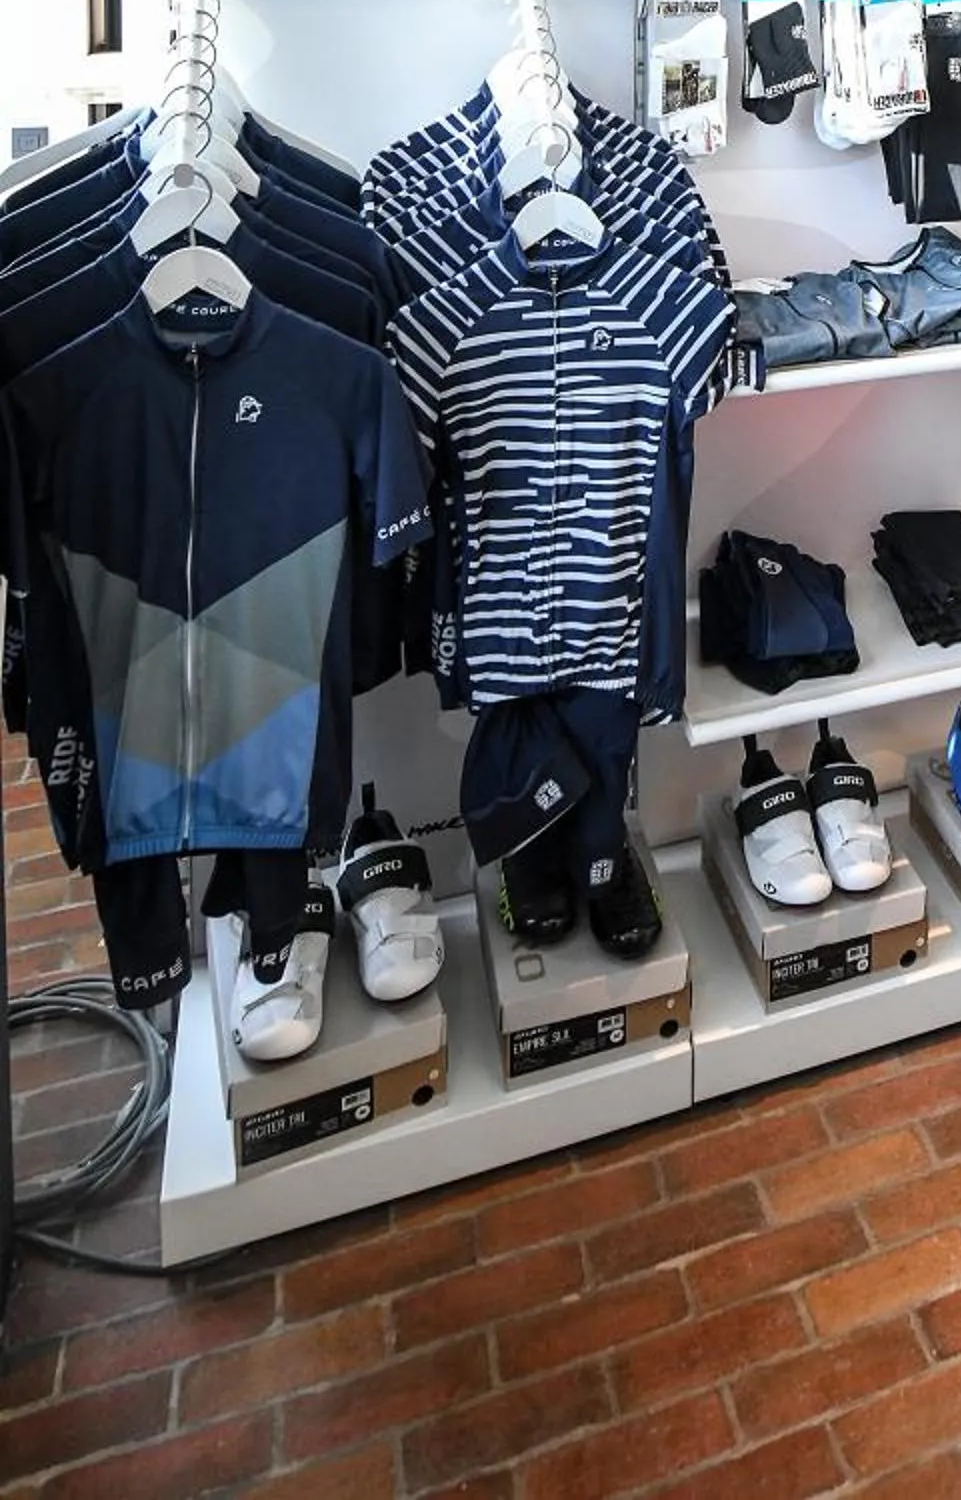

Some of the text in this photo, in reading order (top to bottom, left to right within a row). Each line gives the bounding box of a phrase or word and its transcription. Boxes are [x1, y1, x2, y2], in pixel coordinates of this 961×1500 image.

[833, 775, 864, 786] GIRO
[763, 791, 796, 809] GIRO
[363, 859, 403, 880] GIRO
